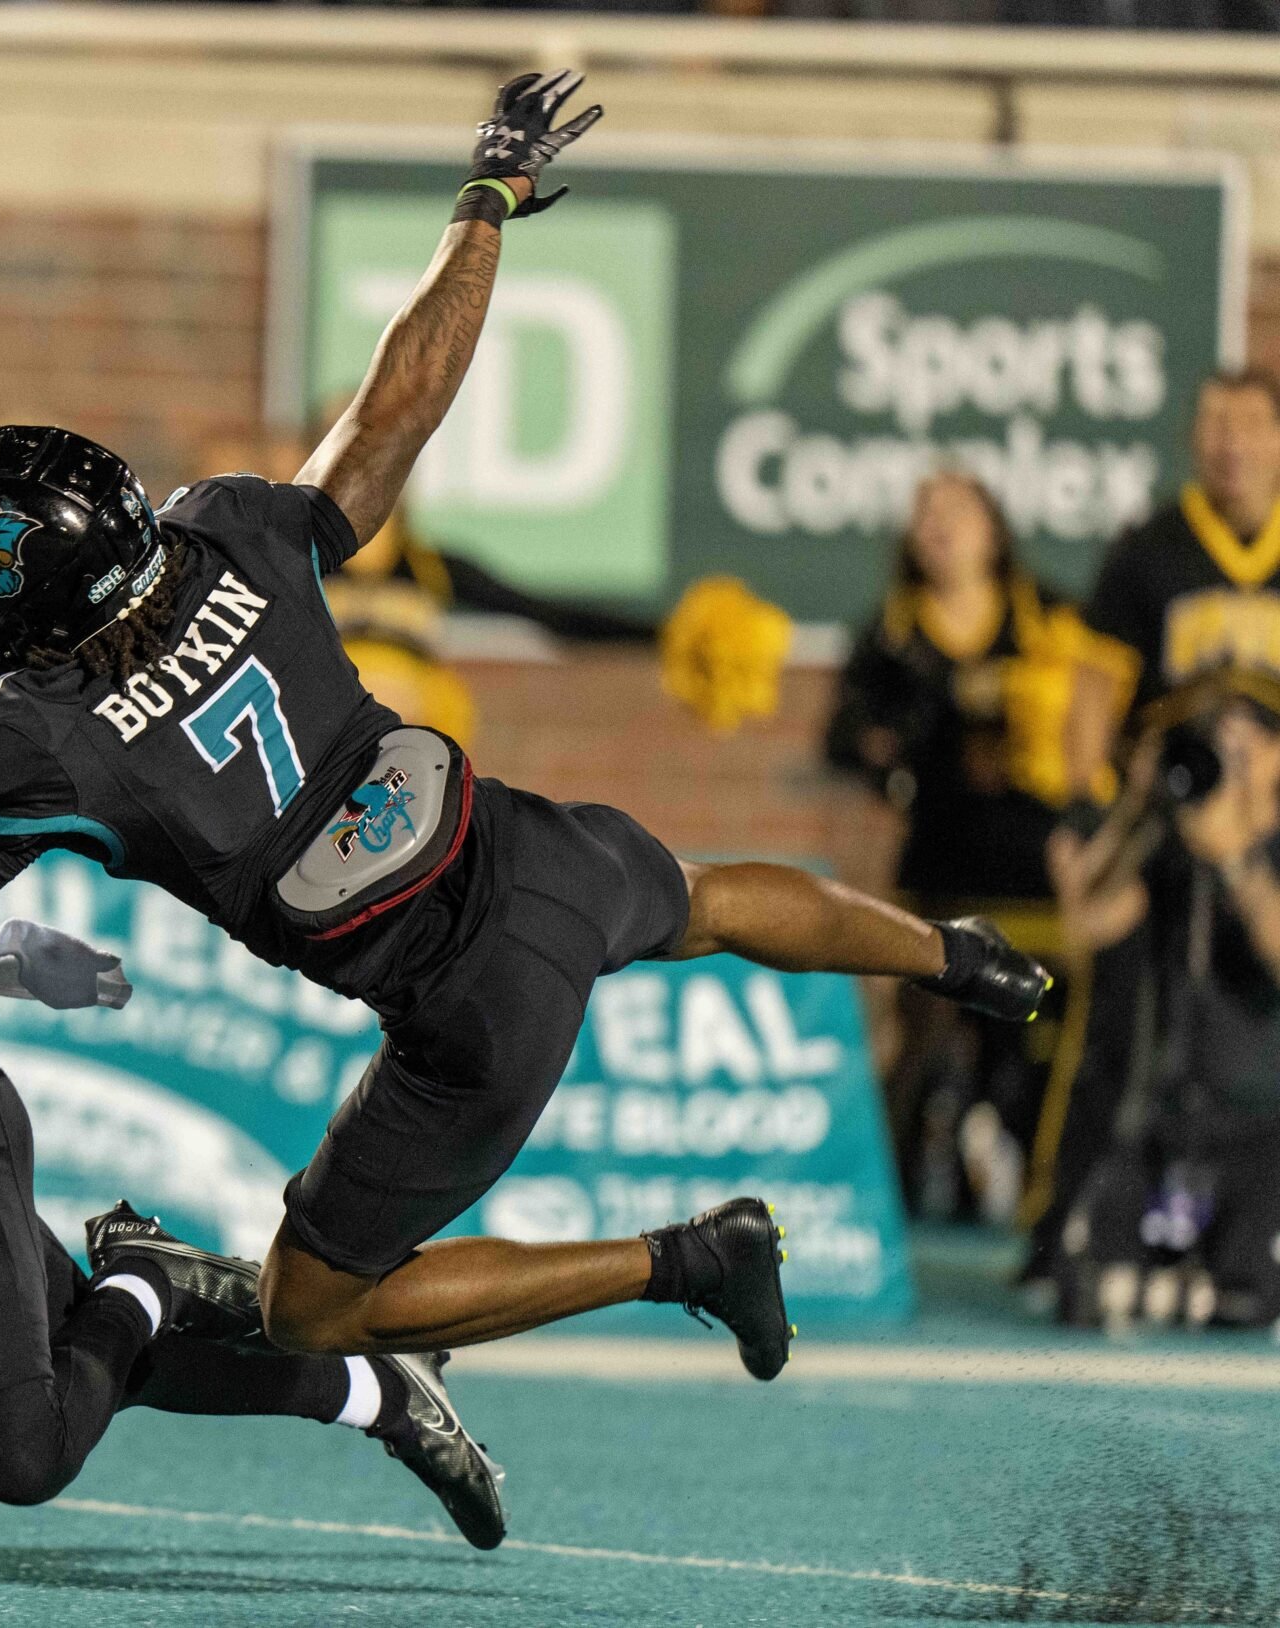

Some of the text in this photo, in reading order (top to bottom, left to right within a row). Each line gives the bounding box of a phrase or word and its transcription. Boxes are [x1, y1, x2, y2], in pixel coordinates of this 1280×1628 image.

[838, 289, 1166, 434] Sports
[87, 564, 126, 604] SBC
[92, 570, 269, 744] BOYKIN
[178, 653, 306, 820] 7
[572, 970, 842, 1083] EAL
[613, 1085, 830, 1157] BLOOD
